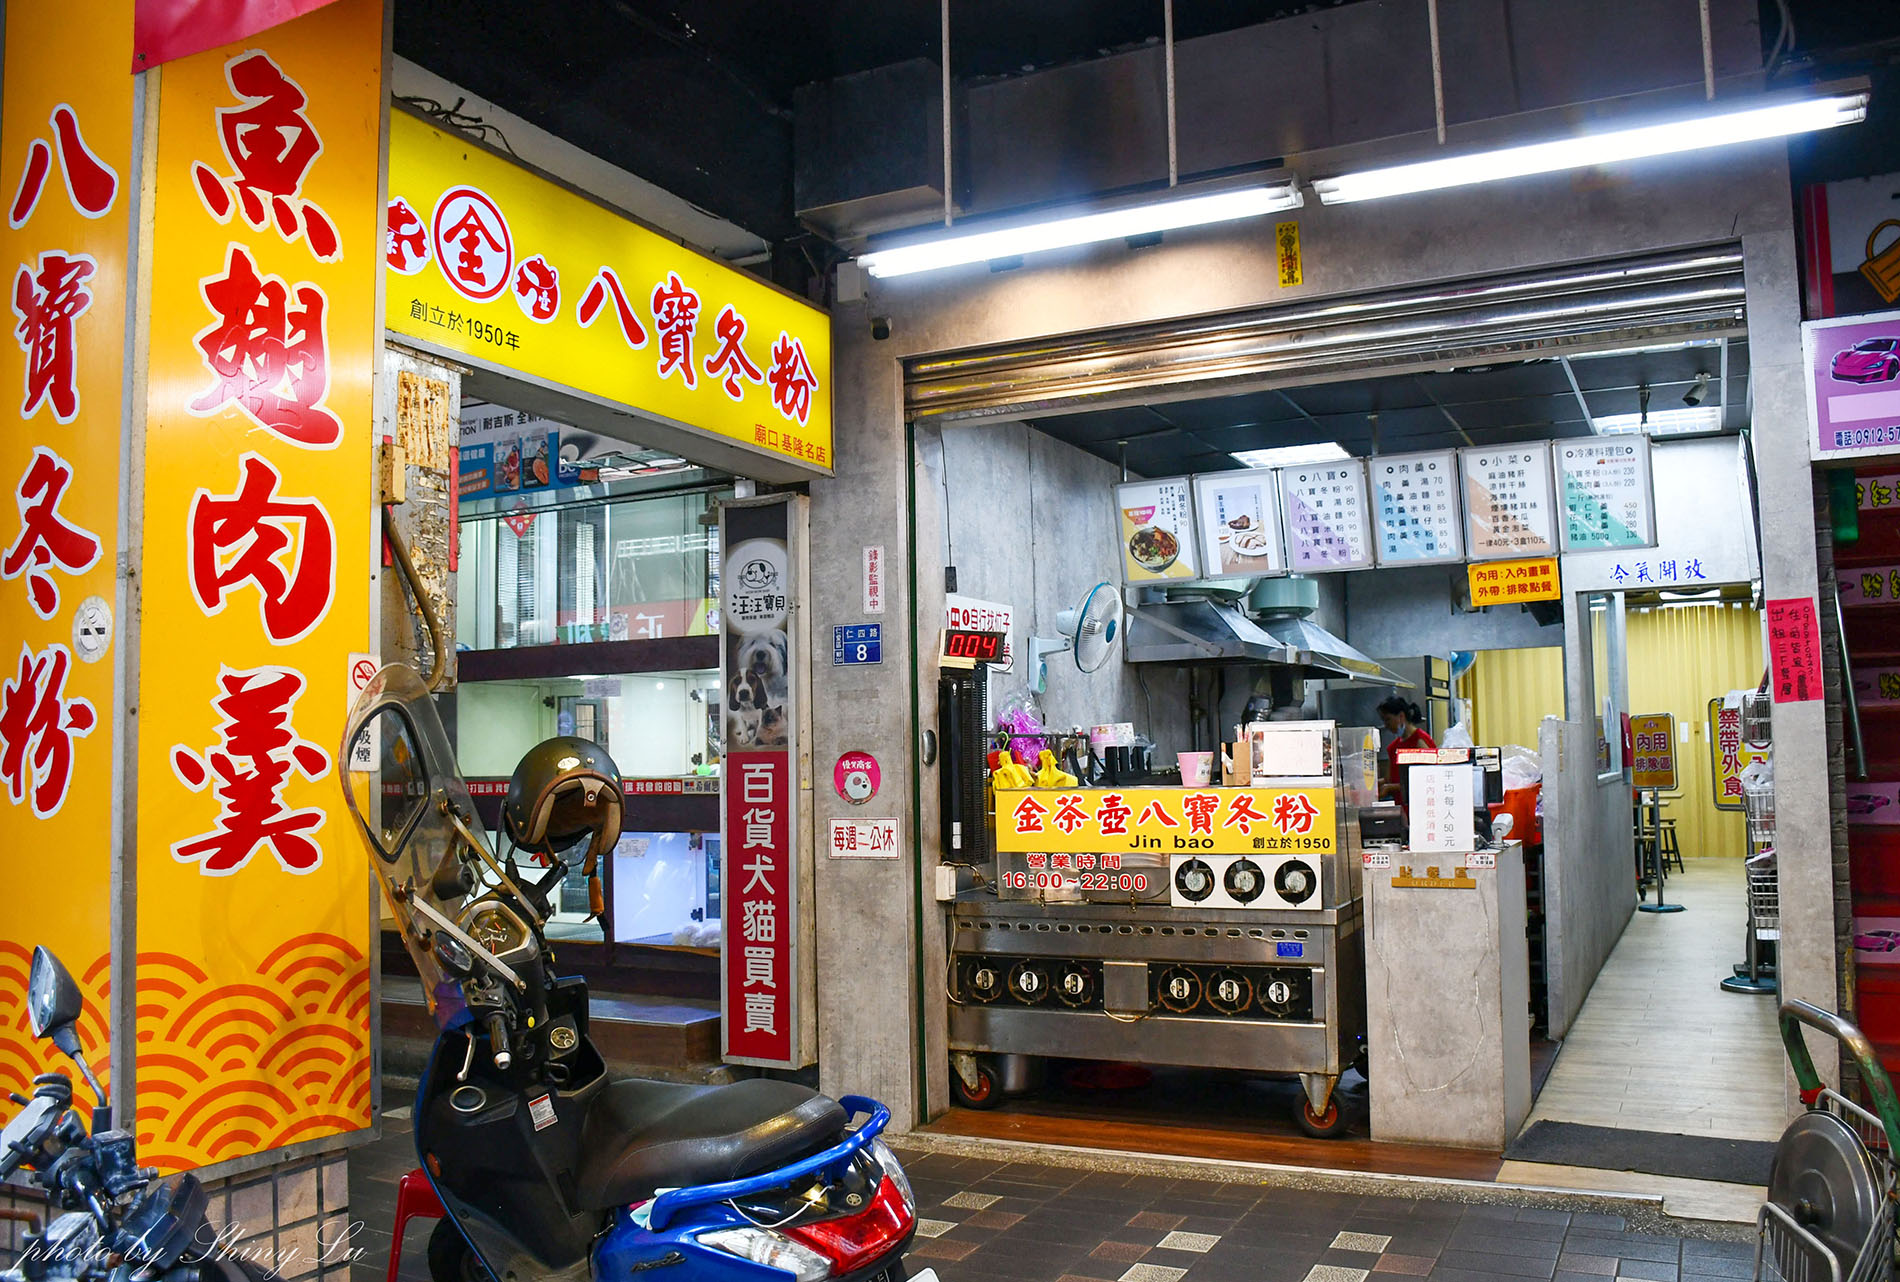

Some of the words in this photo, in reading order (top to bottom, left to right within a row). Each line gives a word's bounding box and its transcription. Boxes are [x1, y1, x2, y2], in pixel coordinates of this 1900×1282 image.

[410, 299, 520, 351] 創立於1950年
[577, 266, 818, 427] 八寶冬粉
[483, 413, 514, 430] 耐吉斯
[755, 424, 778, 448] 廟口
[782, 434, 827, 464] 基隆名店
[1575, 446, 1624, 458] 冷凍料理包
[0, 103, 119, 819] 八寶冬粉
[170, 49, 344, 876] 魚翅肉羹
[1492, 455, 1518, 467] 小菜
[1312, 471, 1335, 481] 八寶
[1488, 470, 1525, 480] 麻油豬肝
[1623, 467, 1635, 475] 230
[1297, 485, 1340, 496] 八寶冬粉
[1489, 481, 1526, 491] 涼拌干絲
[1624, 479, 1635, 487] 220
[1490, 493, 1517, 501] 海帶絲
[1492, 513, 1528, 523] 百香木瓜
[1493, 524, 1530, 534] 黃金泡菜
[868, 549, 879, 609] 錄影監視中
[1610, 558, 1706, 584] 冷氣開放
[732, 594, 785, 615] 汪汪寶貝
[846, 628, 878, 639] 仁四路
[856, 644, 867, 661] 8
[949, 634, 997, 657] 004
[1636, 732, 1668, 753] 內用
[1719, 709, 1743, 797] 禁帶外食
[1013, 793, 1320, 836] 金茶壺八寶冬粉
[1443, 770, 1456, 847] 平均每人50元
[834, 826, 894, 851] 每週二公休
[1129, 835, 1161, 848] Jin
[1174, 835, 1214, 849] bao
[1252, 836, 1331, 850] 創立於1950
[1027, 853, 1121, 870] 營業時間
[1002, 872, 1148, 891] 16:00~22:00
[742, 763, 777, 1036] 百貨犬貓買賣
